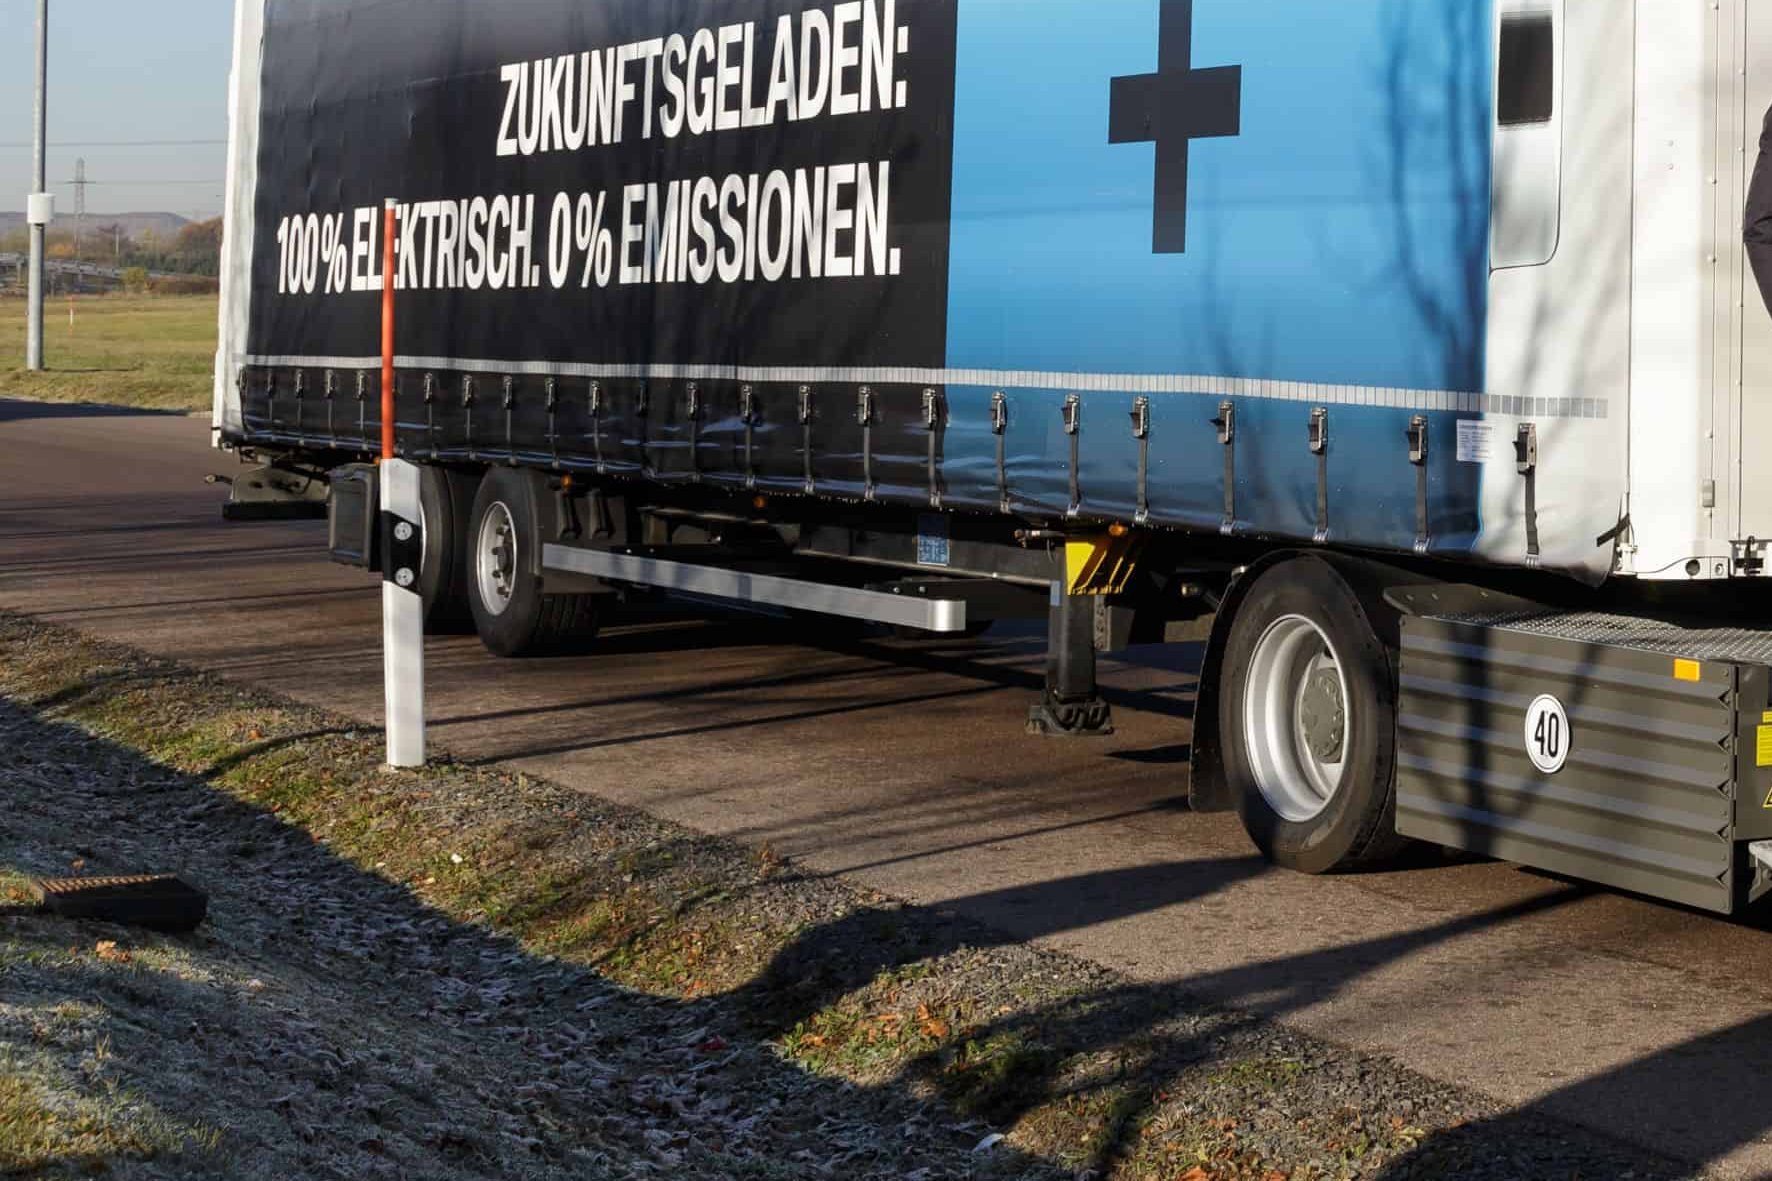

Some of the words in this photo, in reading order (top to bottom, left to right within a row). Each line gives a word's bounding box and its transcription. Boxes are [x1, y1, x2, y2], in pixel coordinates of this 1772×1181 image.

[277, 212, 347, 295] 100%
[619, 160, 901, 285] EMISSIONEN.
[1534, 710, 1560, 757] 40
